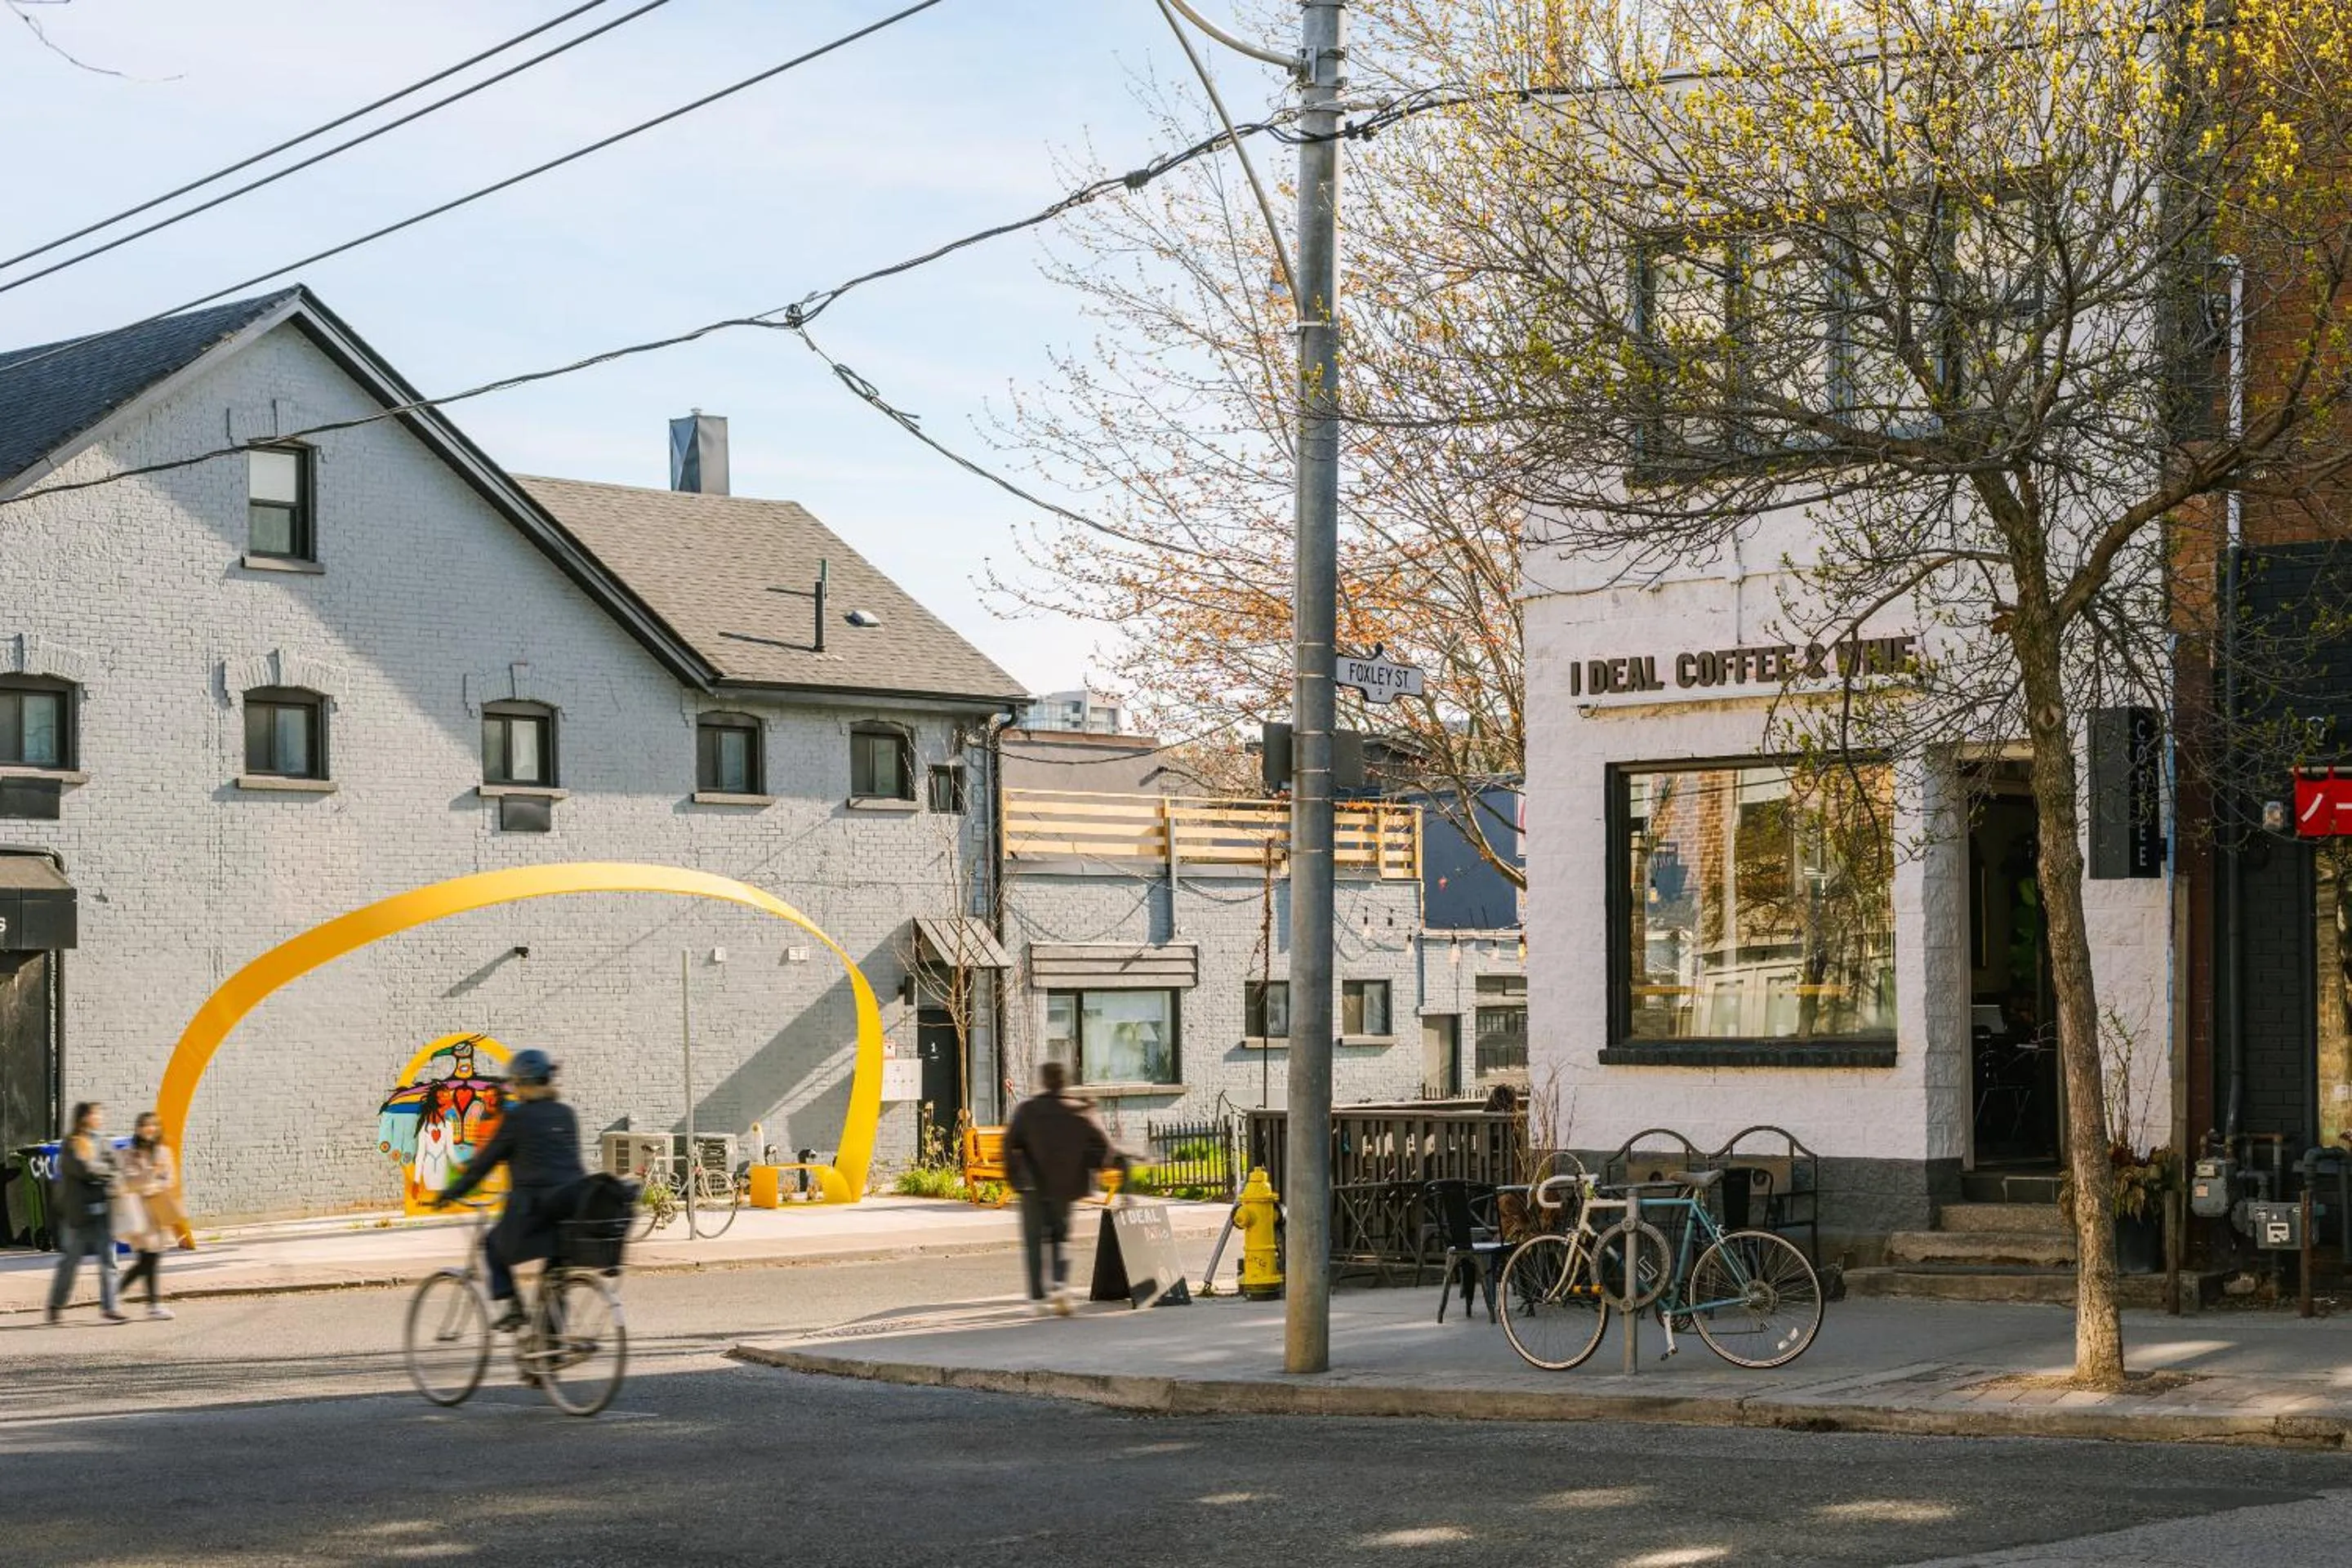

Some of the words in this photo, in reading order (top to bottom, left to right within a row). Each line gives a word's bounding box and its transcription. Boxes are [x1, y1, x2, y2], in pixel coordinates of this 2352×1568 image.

[1349, 662, 1393, 686] FOXLEY
[1676, 644, 1796, 688] COFFEE
[1805, 642, 1828, 679] &
[2136, 719, 2148, 866] COFEE
